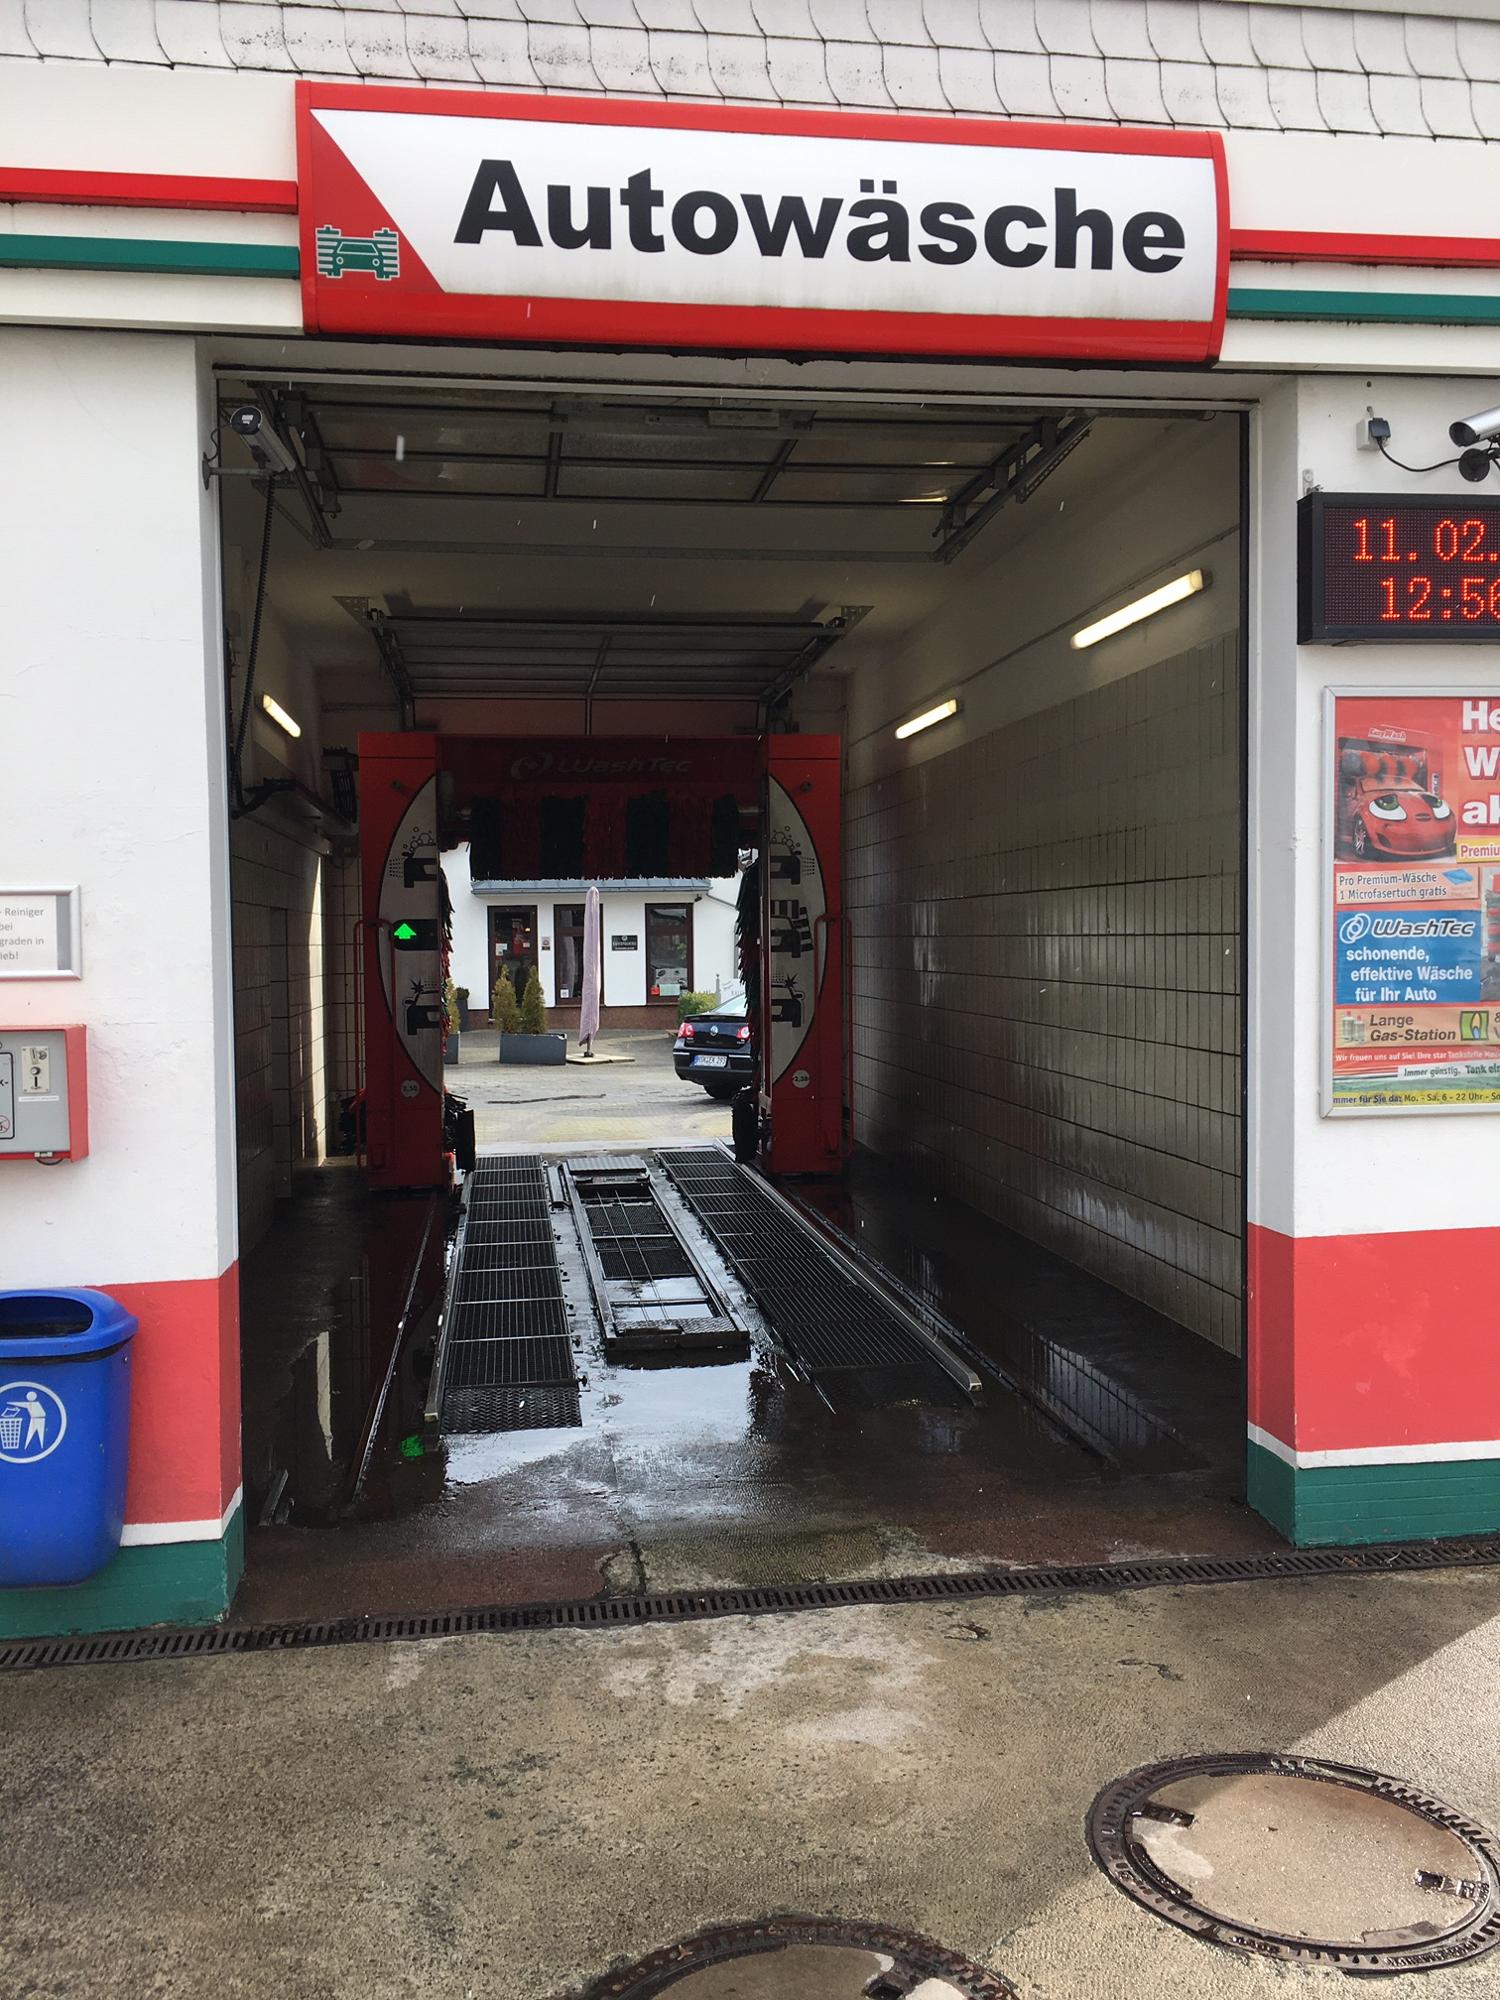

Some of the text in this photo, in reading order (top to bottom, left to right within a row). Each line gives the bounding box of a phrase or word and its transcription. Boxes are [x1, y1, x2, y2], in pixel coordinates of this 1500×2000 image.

[453, 158, 1186, 274] Autowäsche
[1339, 872, 1437, 886] Pro Premium-Wäsche
[1340, 891, 1345, 900] 1
[1348, 886, 1417, 899] Microfasertuch
[1419, 886, 1447, 899] gratis
[4, 907, 45, 918] Reiniger
[1372, 918, 1475, 937] WashTec
[36, 937, 45, 945] in
[1346, 946, 1430, 962] schonende,
[1350, 965, 1473, 981] effektive Wäsche
[1355, 986, 1437, 1002] für Ihr Auto
[1369, 1014, 1414, 1028] Lange
[1369, 1028, 1456, 1041] Gas-Station
[1335, 1053, 1348, 1061] Wir
[1350, 1053, 1373, 1061] freuen
[1404, 1068, 1428, 1077] Immer
[1430, 1066, 1461, 1077] günstig.
[1465, 1064, 1487, 1074] Tank
[1359, 1095, 1372, 1103] für
[1441, 1093, 1448, 1101] 6
[1455, 1093, 1466, 1101] 22
[1468, 1091, 1484, 1101] Uhr
